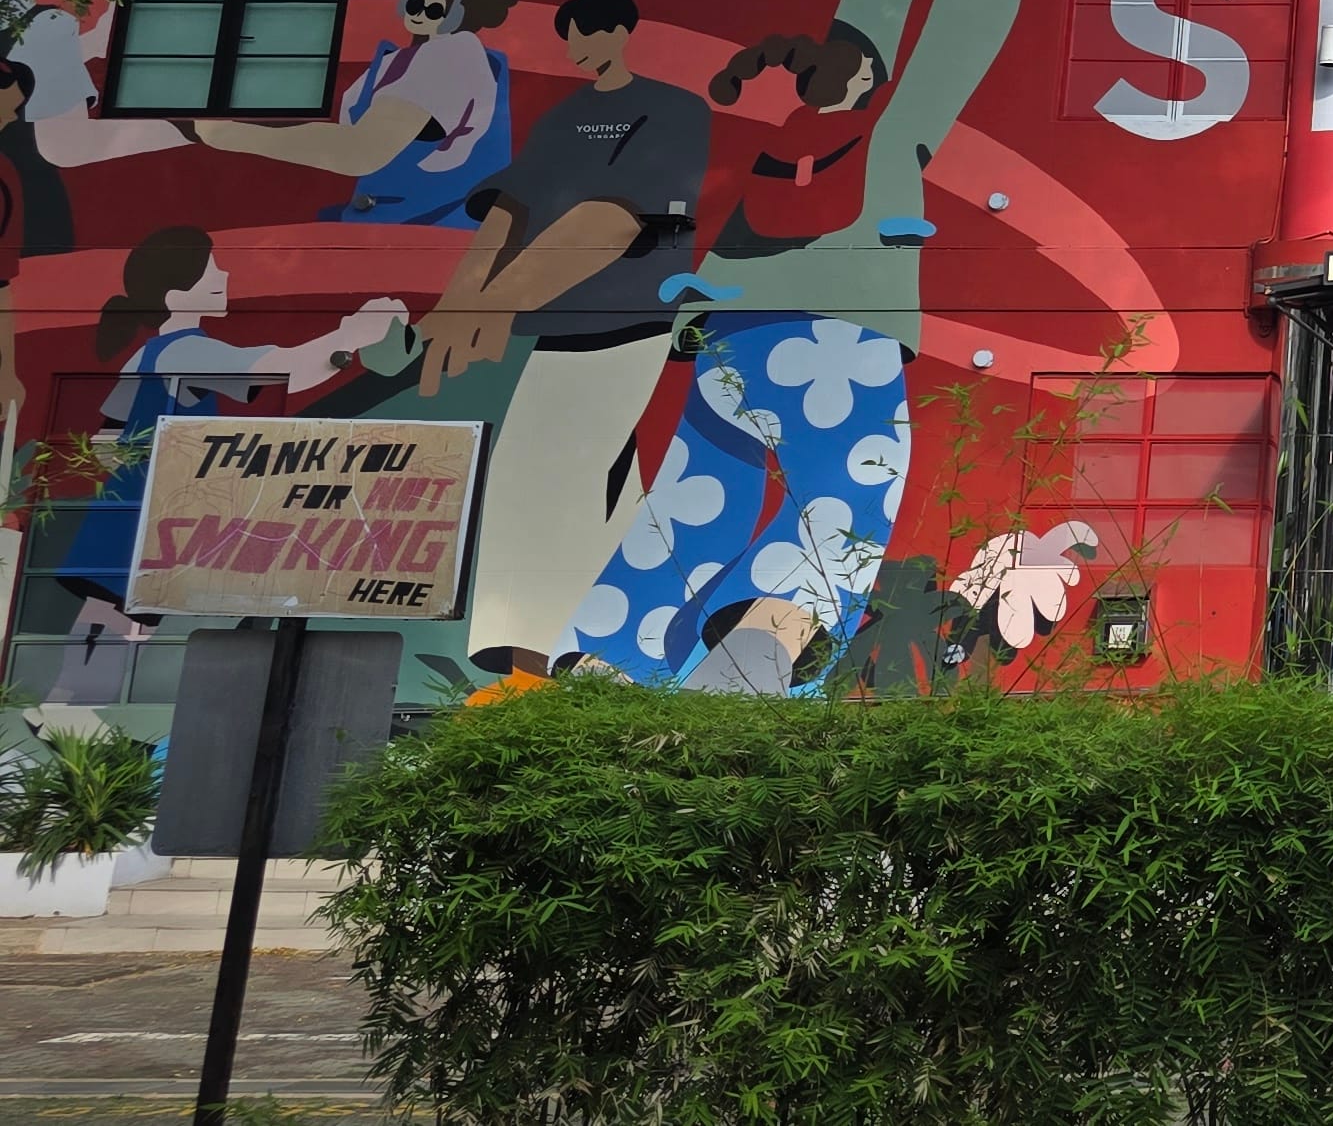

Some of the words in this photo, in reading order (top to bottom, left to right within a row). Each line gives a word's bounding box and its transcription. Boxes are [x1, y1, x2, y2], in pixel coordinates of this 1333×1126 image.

[576, 124, 614, 133] YOUTH
[195, 432, 338, 479] THANK
[340, 442, 418, 474] YOU
[282, 484, 353, 510] FOR
[362, 476, 457, 512] NOT
[138, 514, 459, 574] SMOKING
[347, 578, 434, 608] HERE
